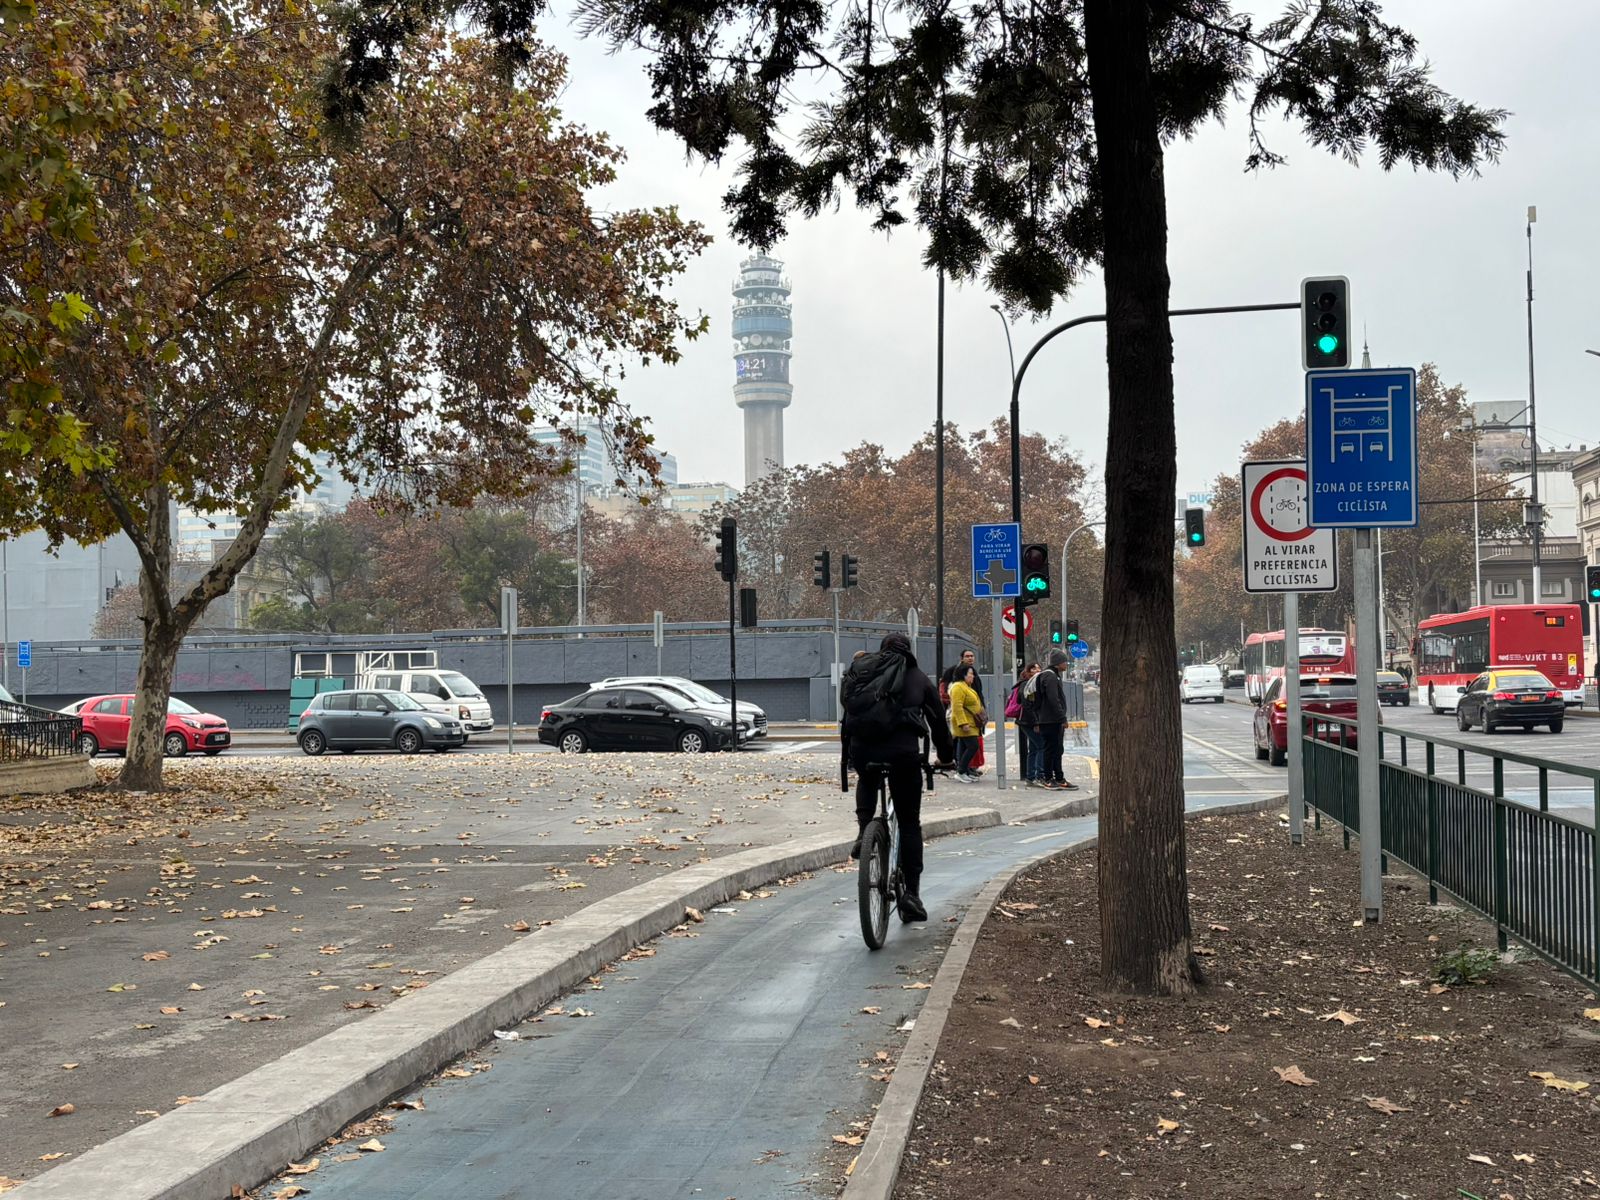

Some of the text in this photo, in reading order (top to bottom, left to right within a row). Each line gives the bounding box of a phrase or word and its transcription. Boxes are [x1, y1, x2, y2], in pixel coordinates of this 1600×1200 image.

[1315, 480, 1410, 493] ZONA DE ESPERA
[1337, 501, 1388, 512] CICLISTA
[1264, 544, 1315, 556] AL VIRAR
[1253, 559, 1328, 571] PREFERENCIA
[1263, 574, 1318, 585] CICLISTAS
[1525, 654, 1547, 662] VJKT
